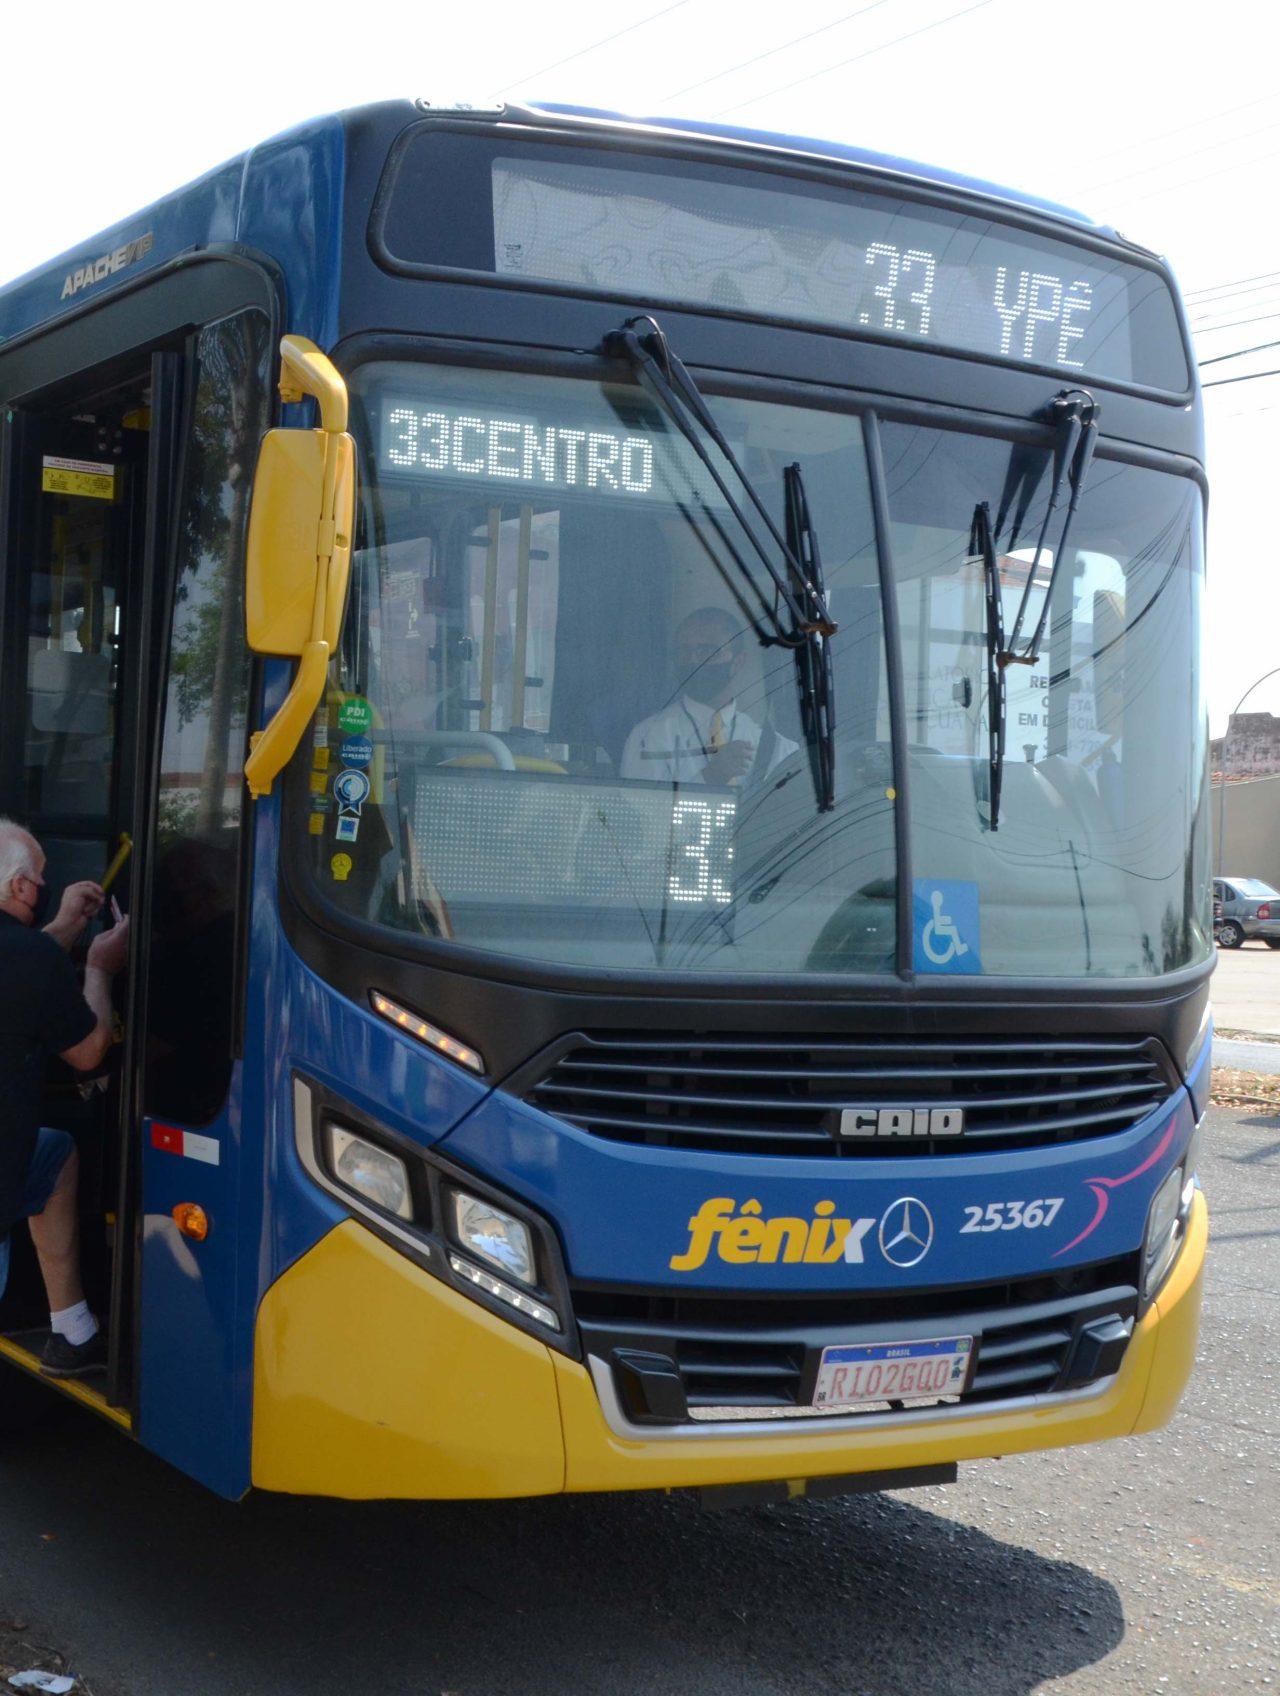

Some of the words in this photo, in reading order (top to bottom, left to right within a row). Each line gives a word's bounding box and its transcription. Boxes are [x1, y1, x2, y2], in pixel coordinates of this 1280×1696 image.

[859, 242, 936, 335] 33
[346, 706, 366, 717] PDI
[839, 1108, 963, 1136] CAIO
[959, 1198, 1064, 1234] 25367
[669, 1197, 876, 1272] fênix
